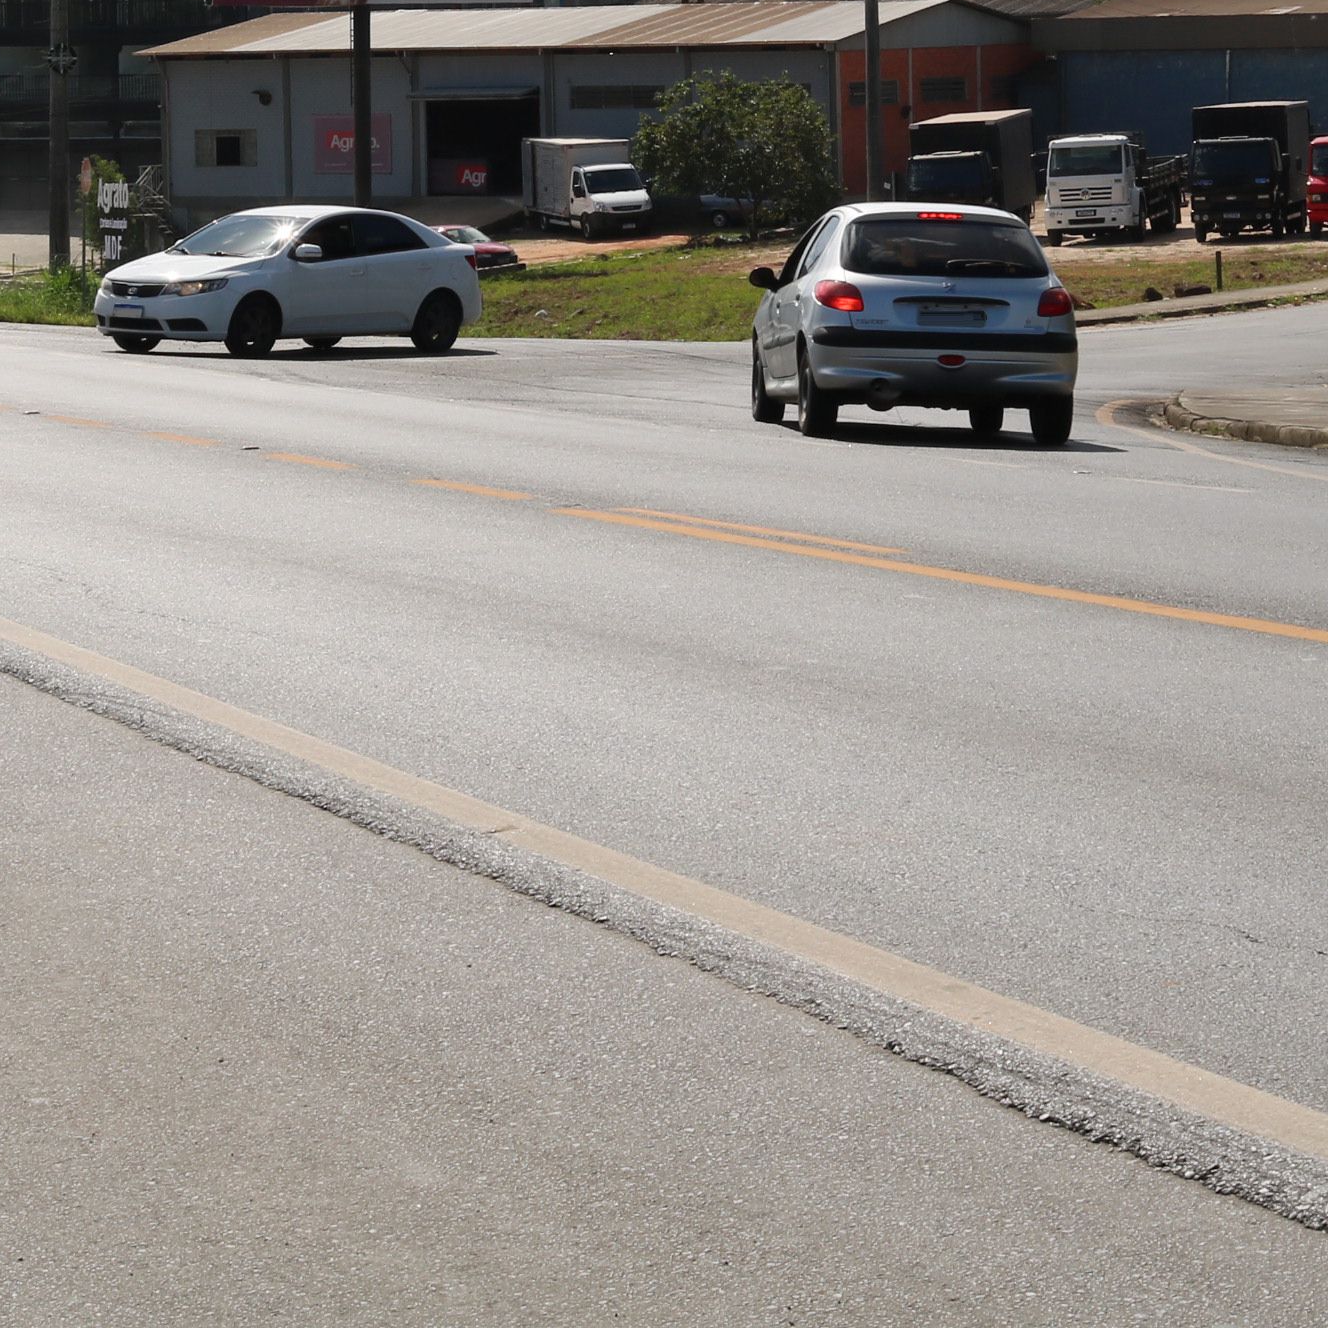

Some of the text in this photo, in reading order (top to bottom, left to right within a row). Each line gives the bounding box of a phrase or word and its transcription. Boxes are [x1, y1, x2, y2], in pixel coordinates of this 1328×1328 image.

[330, 133, 381, 152] Agro.
[97, 177, 129, 213] Agrato
[104, 234, 122, 260] MDF
